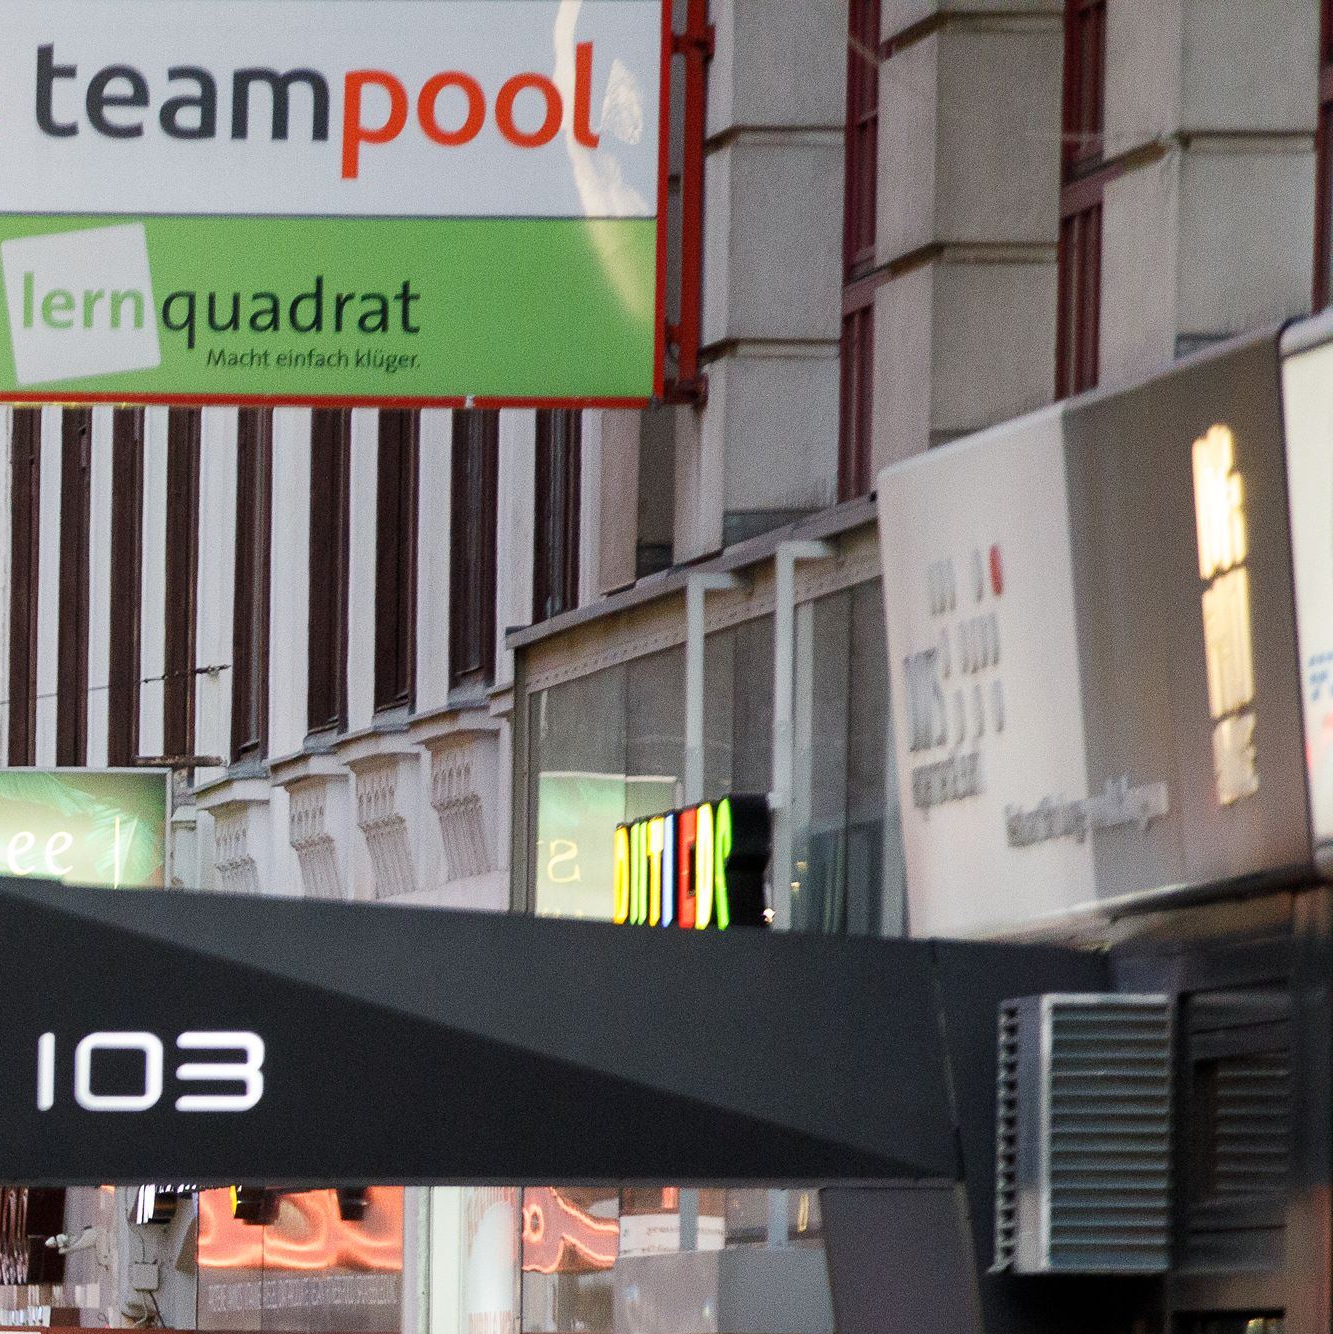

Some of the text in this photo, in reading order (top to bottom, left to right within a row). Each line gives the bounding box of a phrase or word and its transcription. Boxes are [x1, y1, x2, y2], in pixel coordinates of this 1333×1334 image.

[34, 41, 600, 180] teampool
[207, 348, 422, 374] Macht einfach klüger.
[38, 1031, 265, 1112] 103
